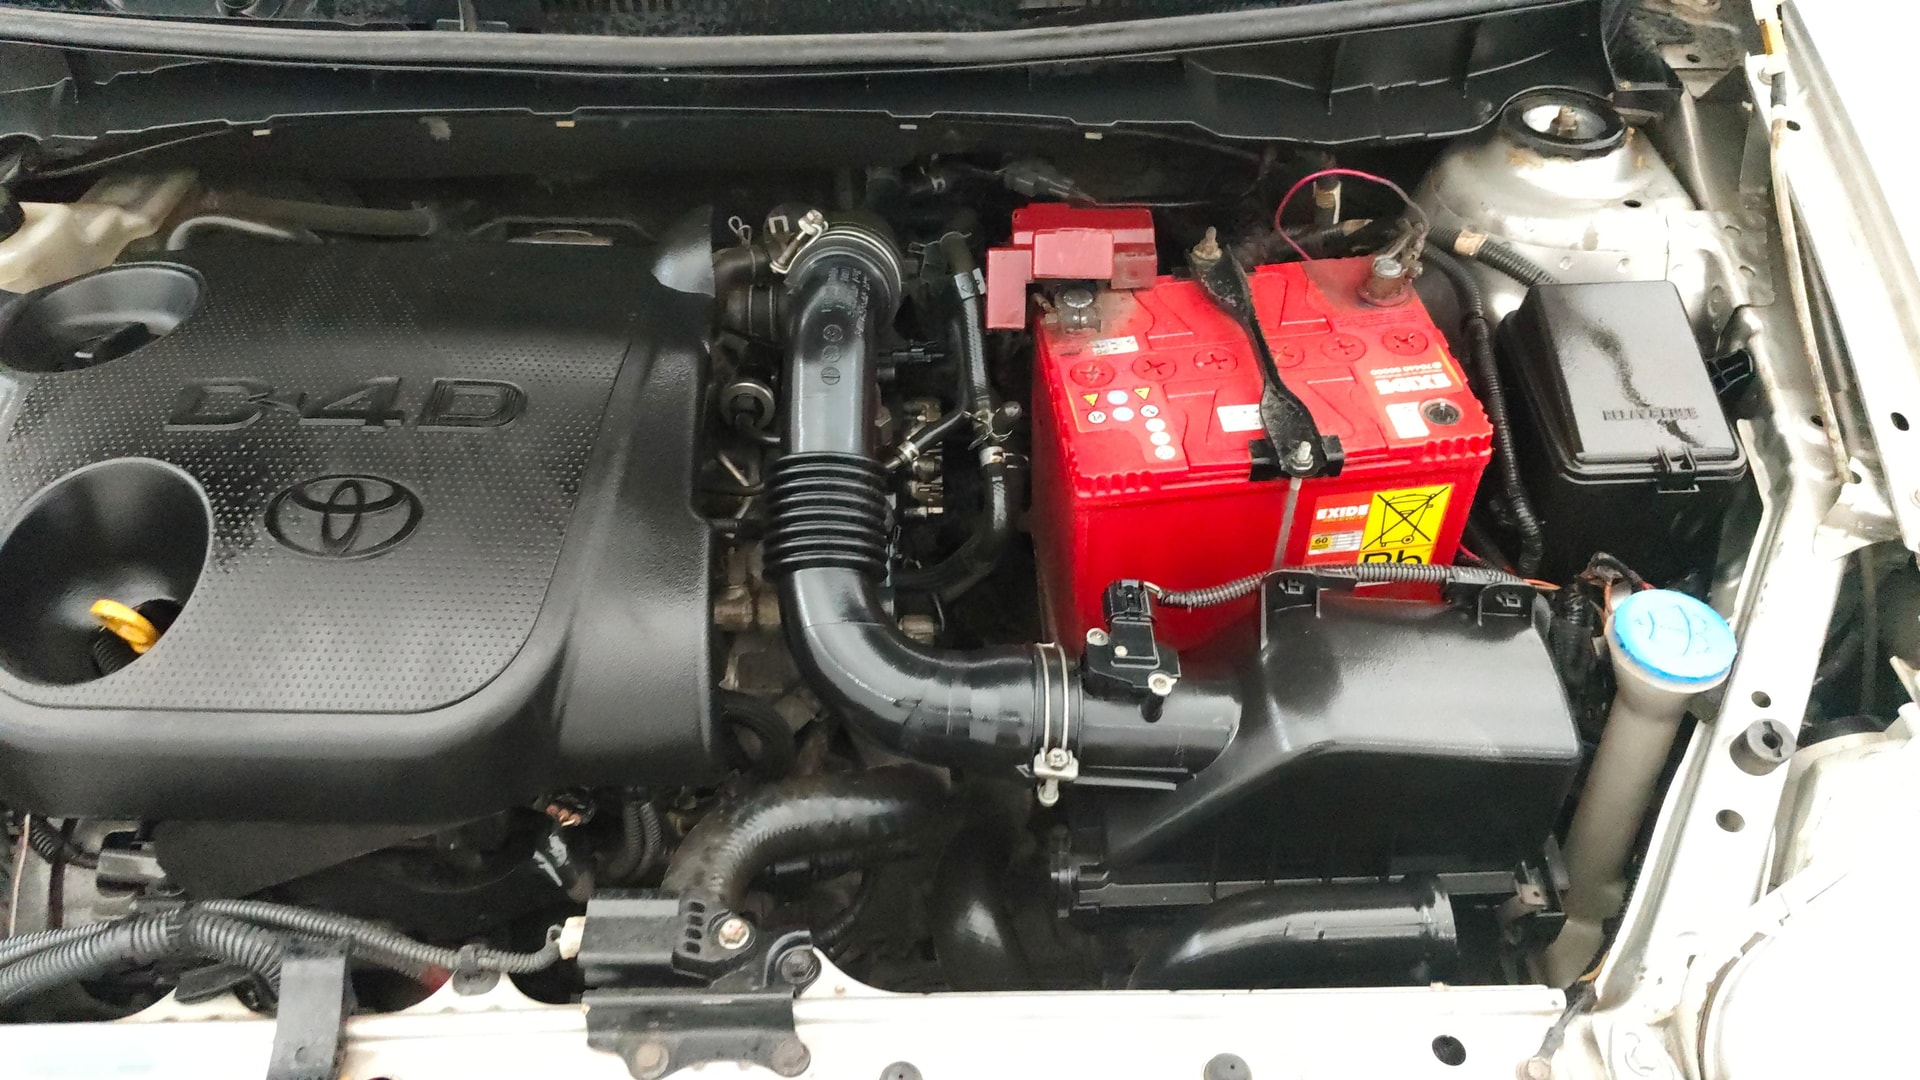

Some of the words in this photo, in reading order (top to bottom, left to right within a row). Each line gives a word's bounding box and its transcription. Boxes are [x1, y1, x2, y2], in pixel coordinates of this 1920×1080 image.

[1375, 374, 1452, 395] EXIDE
[1316, 504, 1370, 520] EXIDE
[1314, 537, 1328, 545] 60
